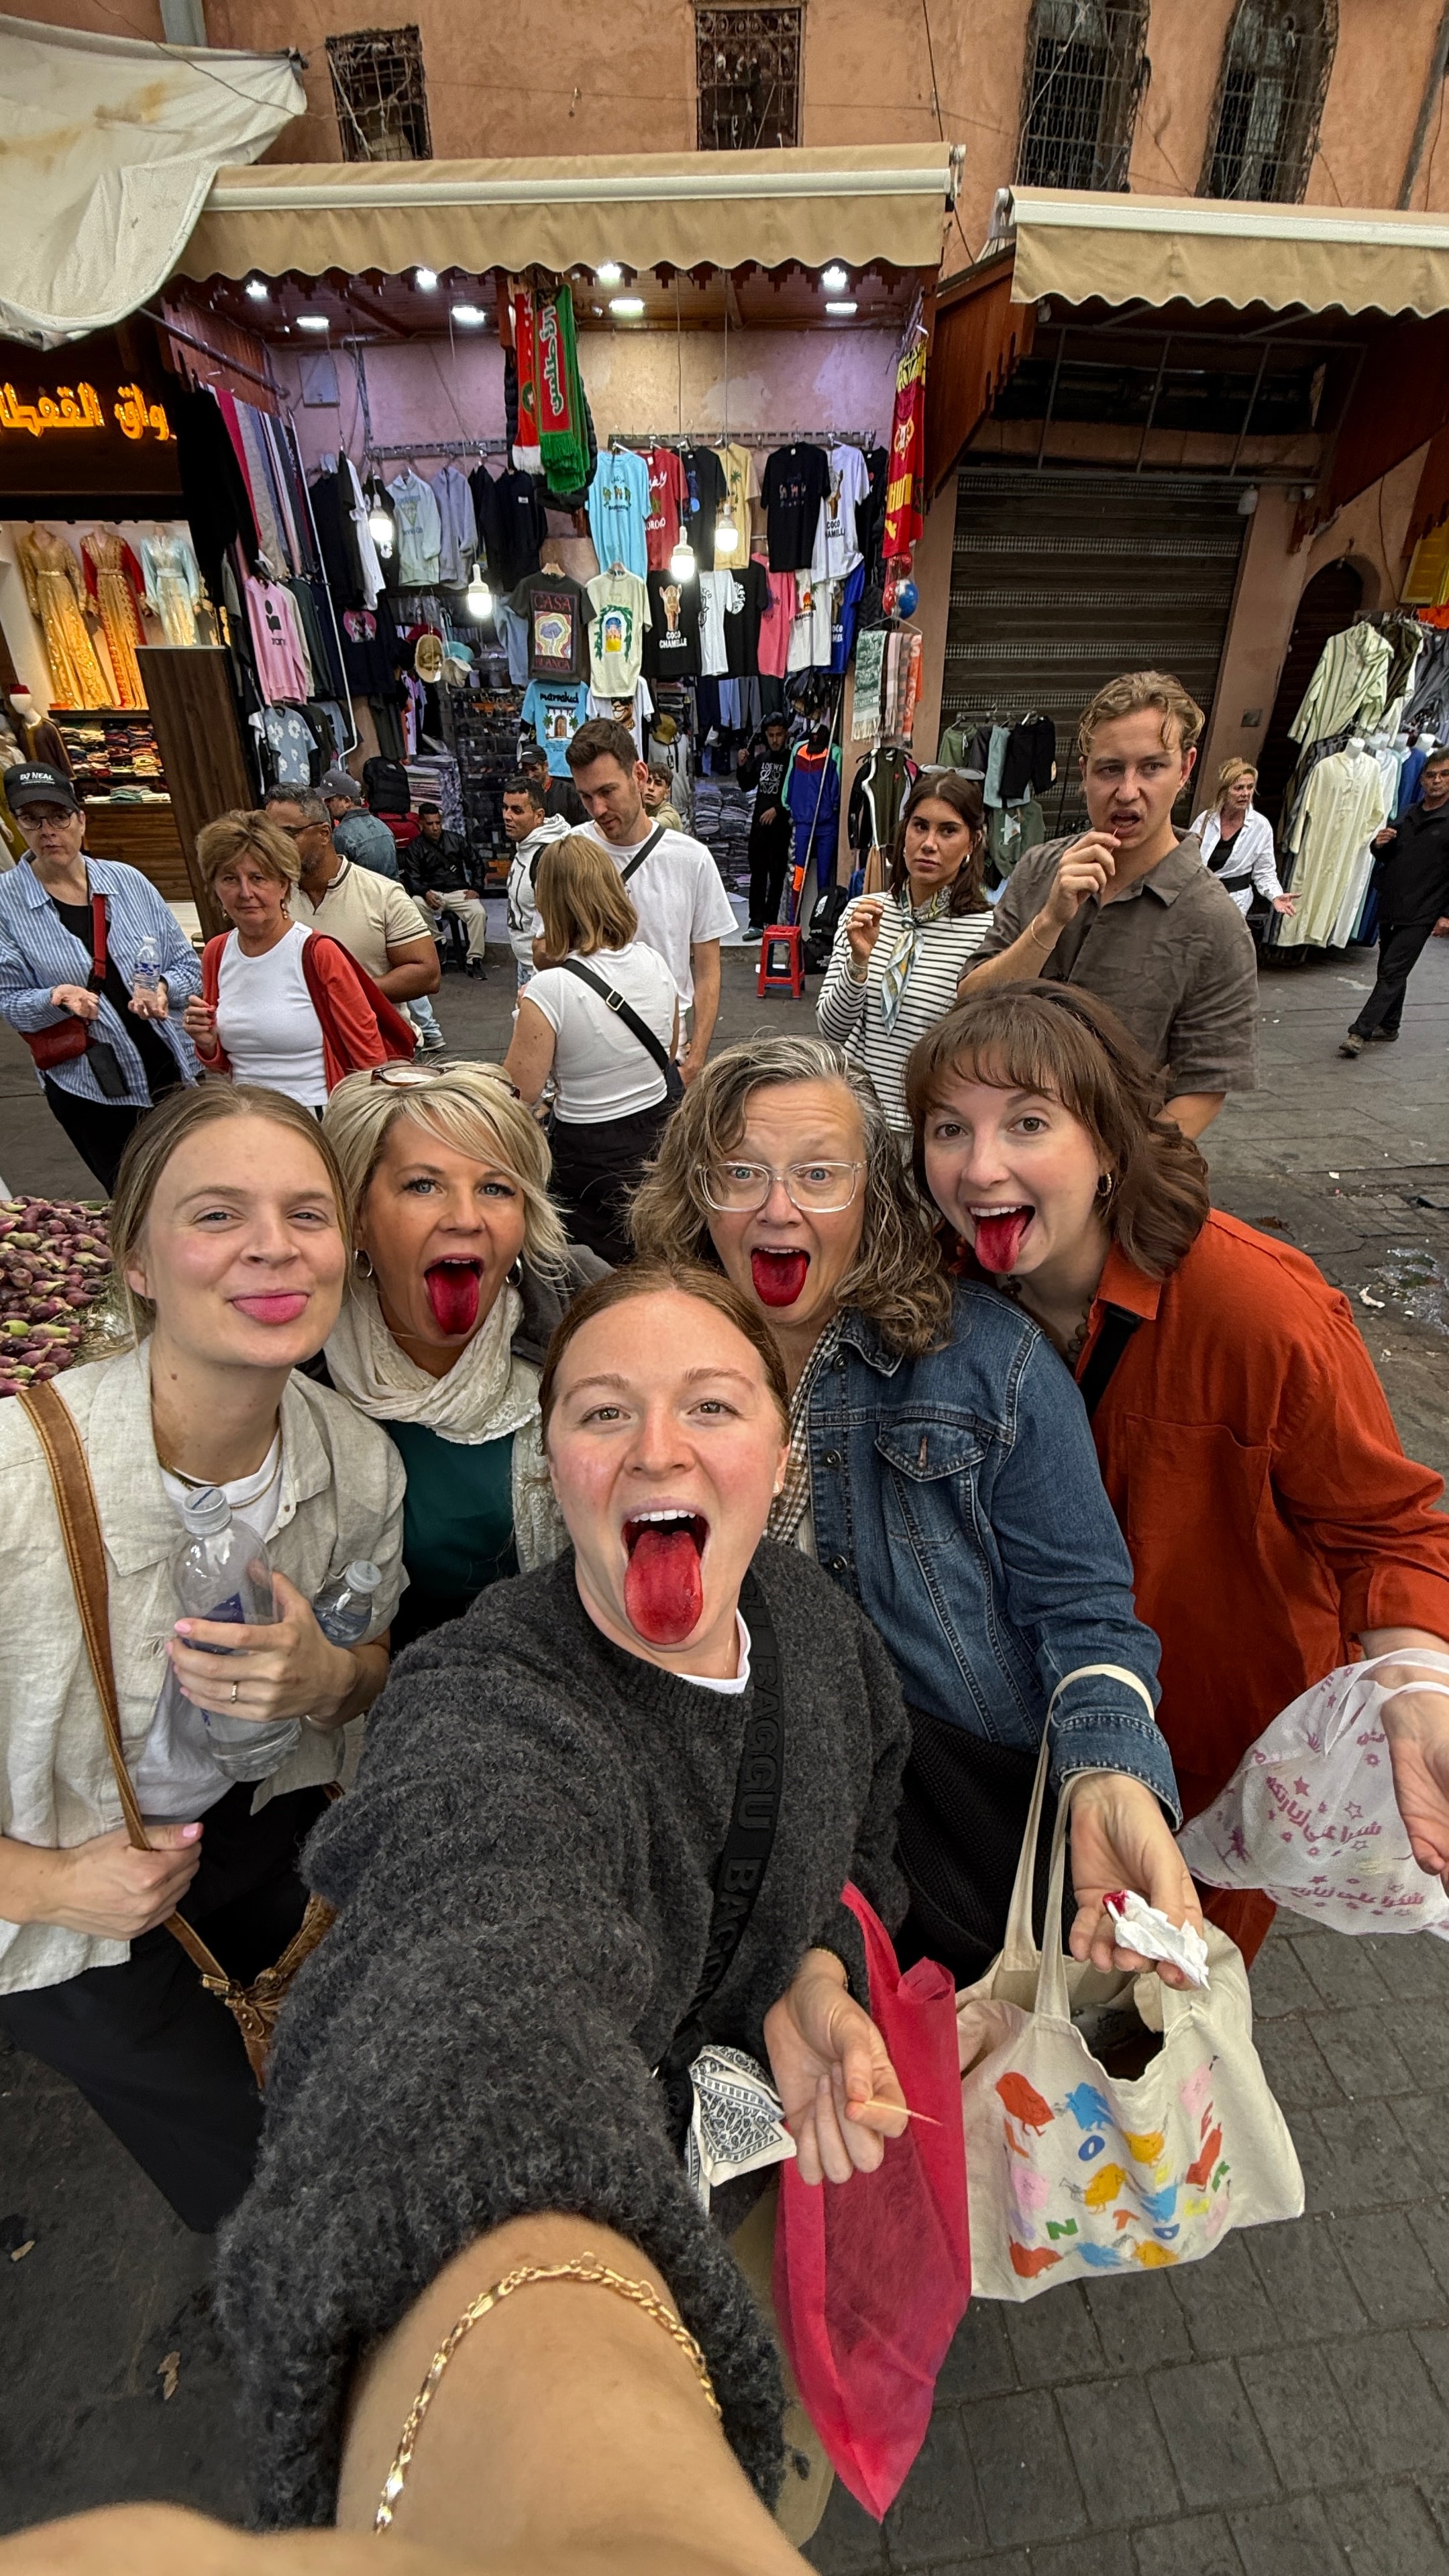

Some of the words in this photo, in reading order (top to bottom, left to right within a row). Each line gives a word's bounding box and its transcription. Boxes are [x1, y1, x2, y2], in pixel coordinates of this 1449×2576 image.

[826, 520, 841, 530] COCO
[534, 594, 572, 611] CASA
[666, 631, 682, 639] COCO
[761, 762, 784, 771] LOEWE
[32, 771, 54, 780] NEAL
[737, 1654, 780, 1831] BAGGU
